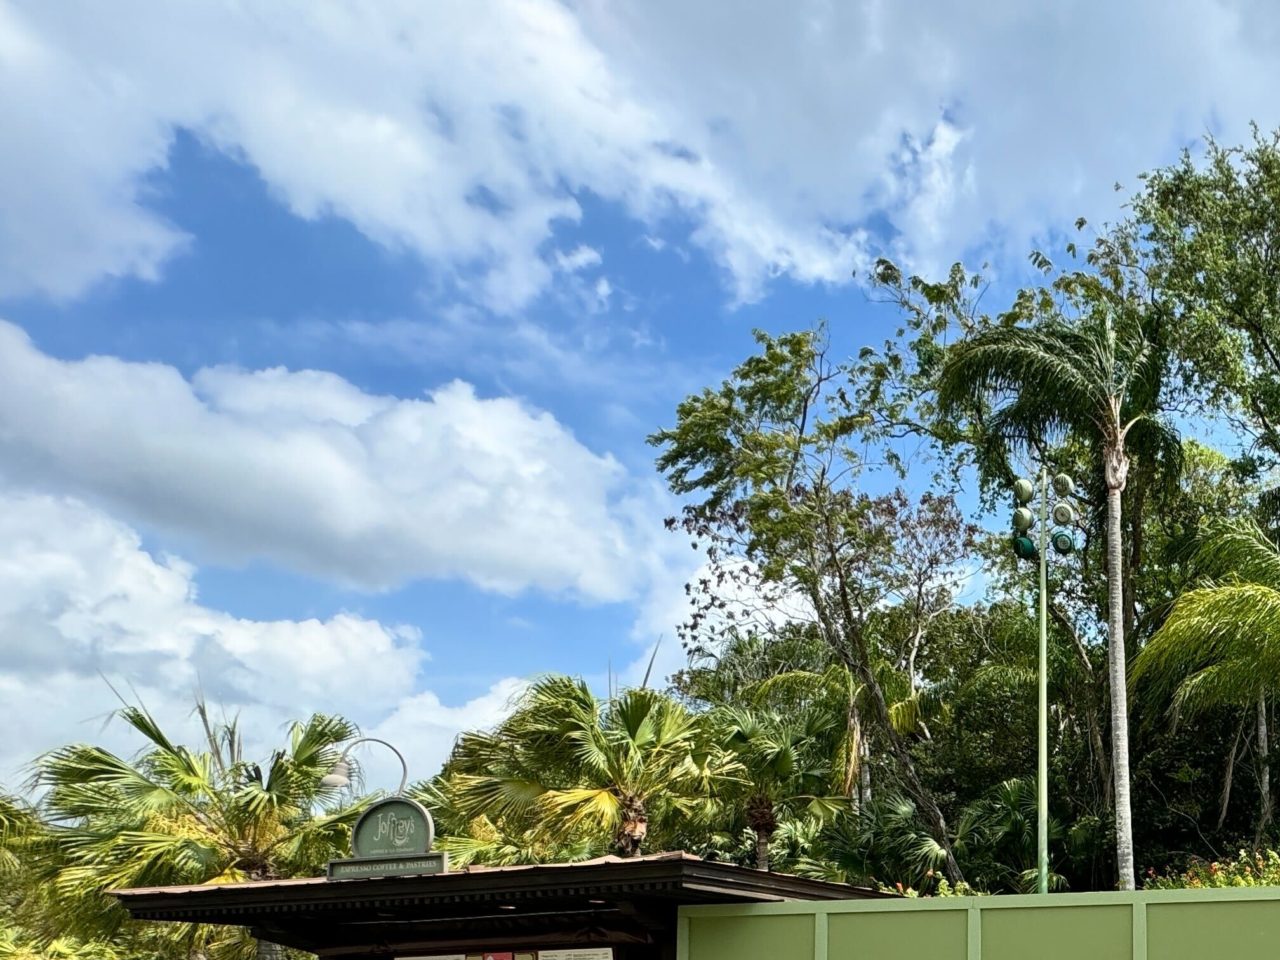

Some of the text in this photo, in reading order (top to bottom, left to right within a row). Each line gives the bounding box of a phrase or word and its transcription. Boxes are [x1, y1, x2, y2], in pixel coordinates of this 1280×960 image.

[373, 812, 415, 843] Joffrey's
[340, 865, 371, 873] ESPRESSO
[373, 863, 396, 871] COFFEE
[407, 860, 437, 869] PASTRIES
